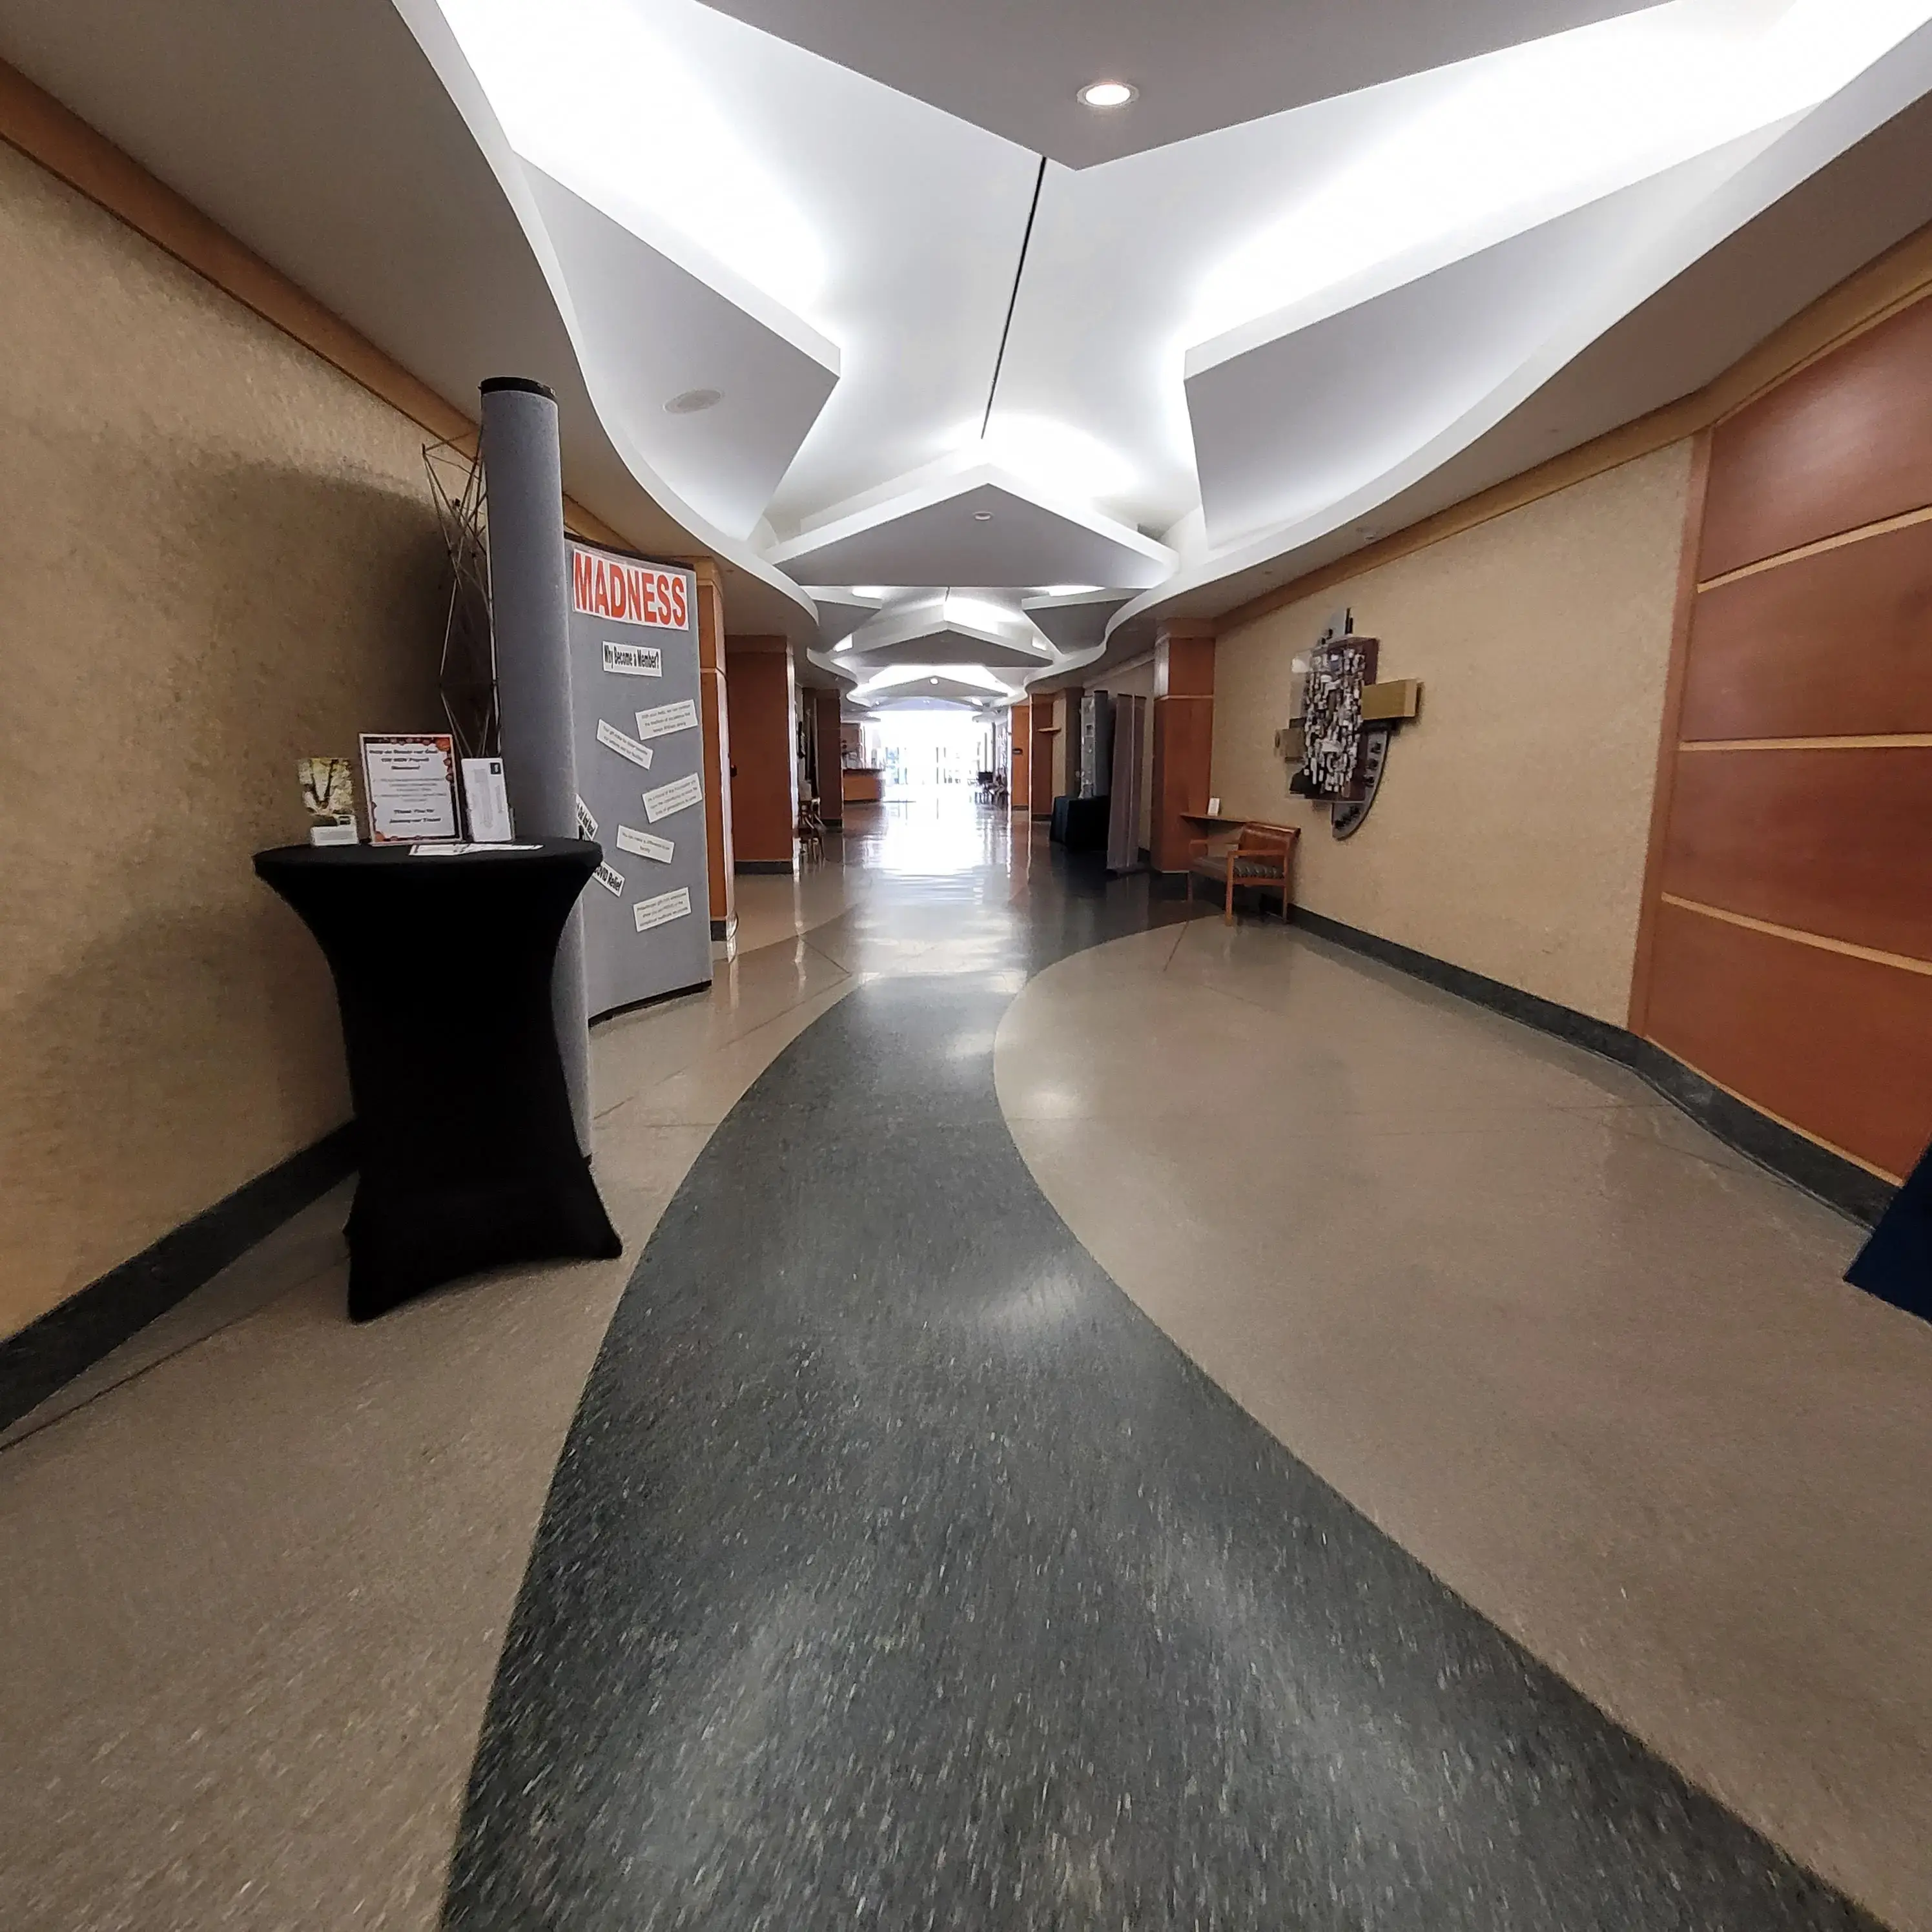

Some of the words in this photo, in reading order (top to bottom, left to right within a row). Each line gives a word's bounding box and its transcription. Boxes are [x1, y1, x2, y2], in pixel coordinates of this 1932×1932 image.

[575, 552, 686, 628] MADNESS
[604, 645, 613, 669] Why
[614, 646, 632, 666] Become
[633, 653, 637, 666] a
[637, 650, 659, 669] Member?
